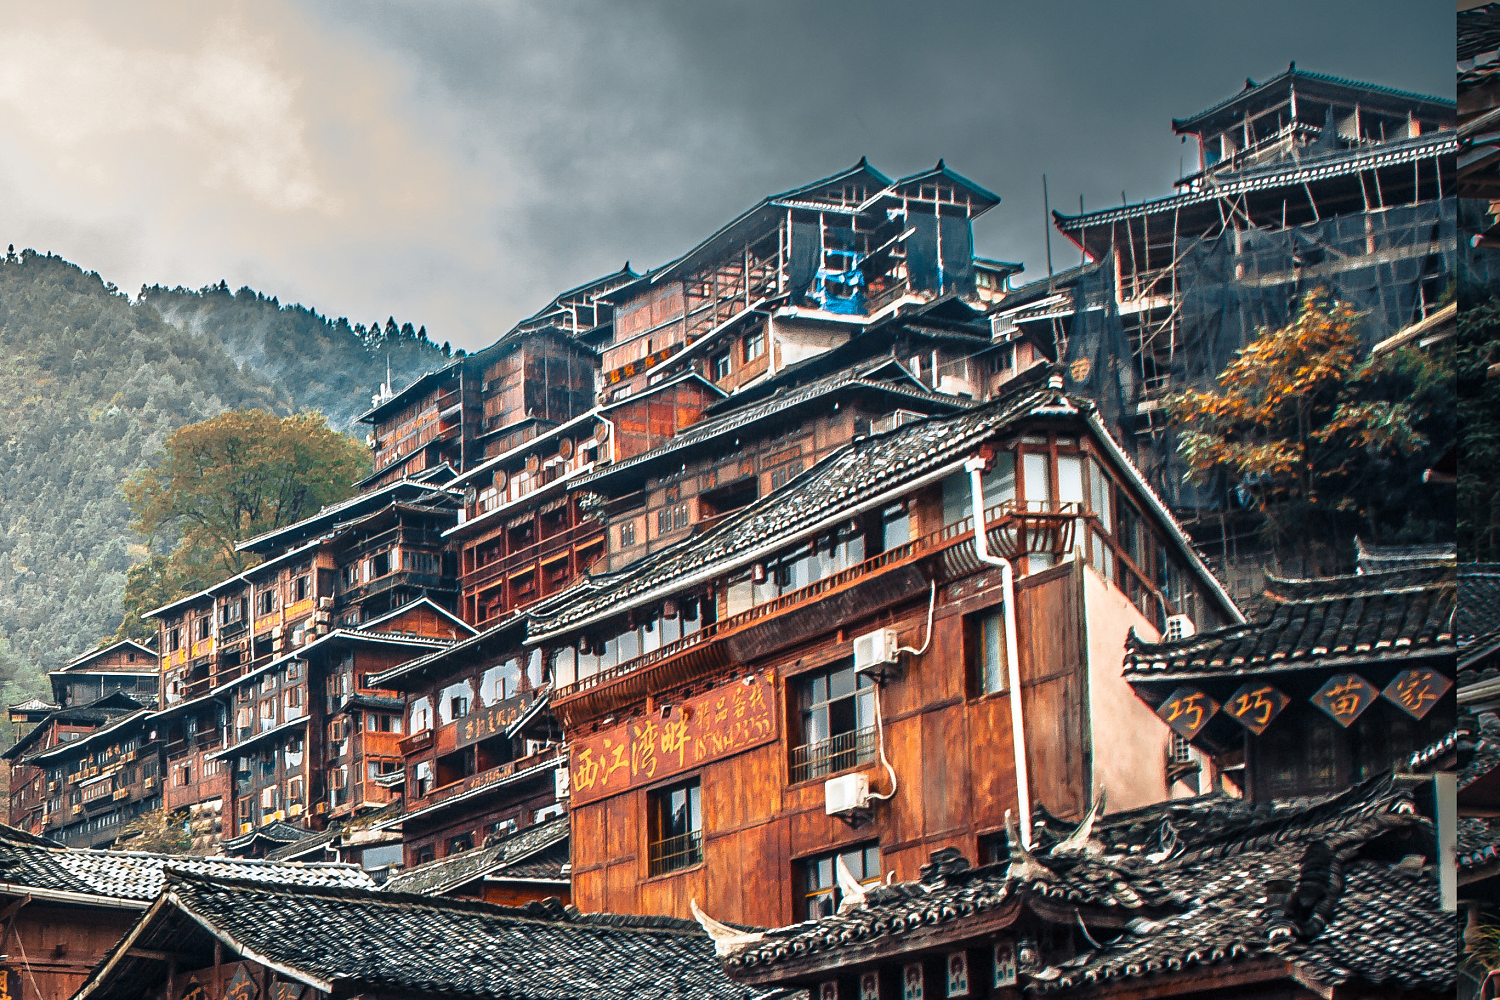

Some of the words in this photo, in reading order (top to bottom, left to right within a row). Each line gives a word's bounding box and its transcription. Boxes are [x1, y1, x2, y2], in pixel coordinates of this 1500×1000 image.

[695, 682, 766, 731] 精品客栈
[1167, 670, 1439, 730] 巧巧苗家
[574, 707, 692, 792] 西江湾畔
